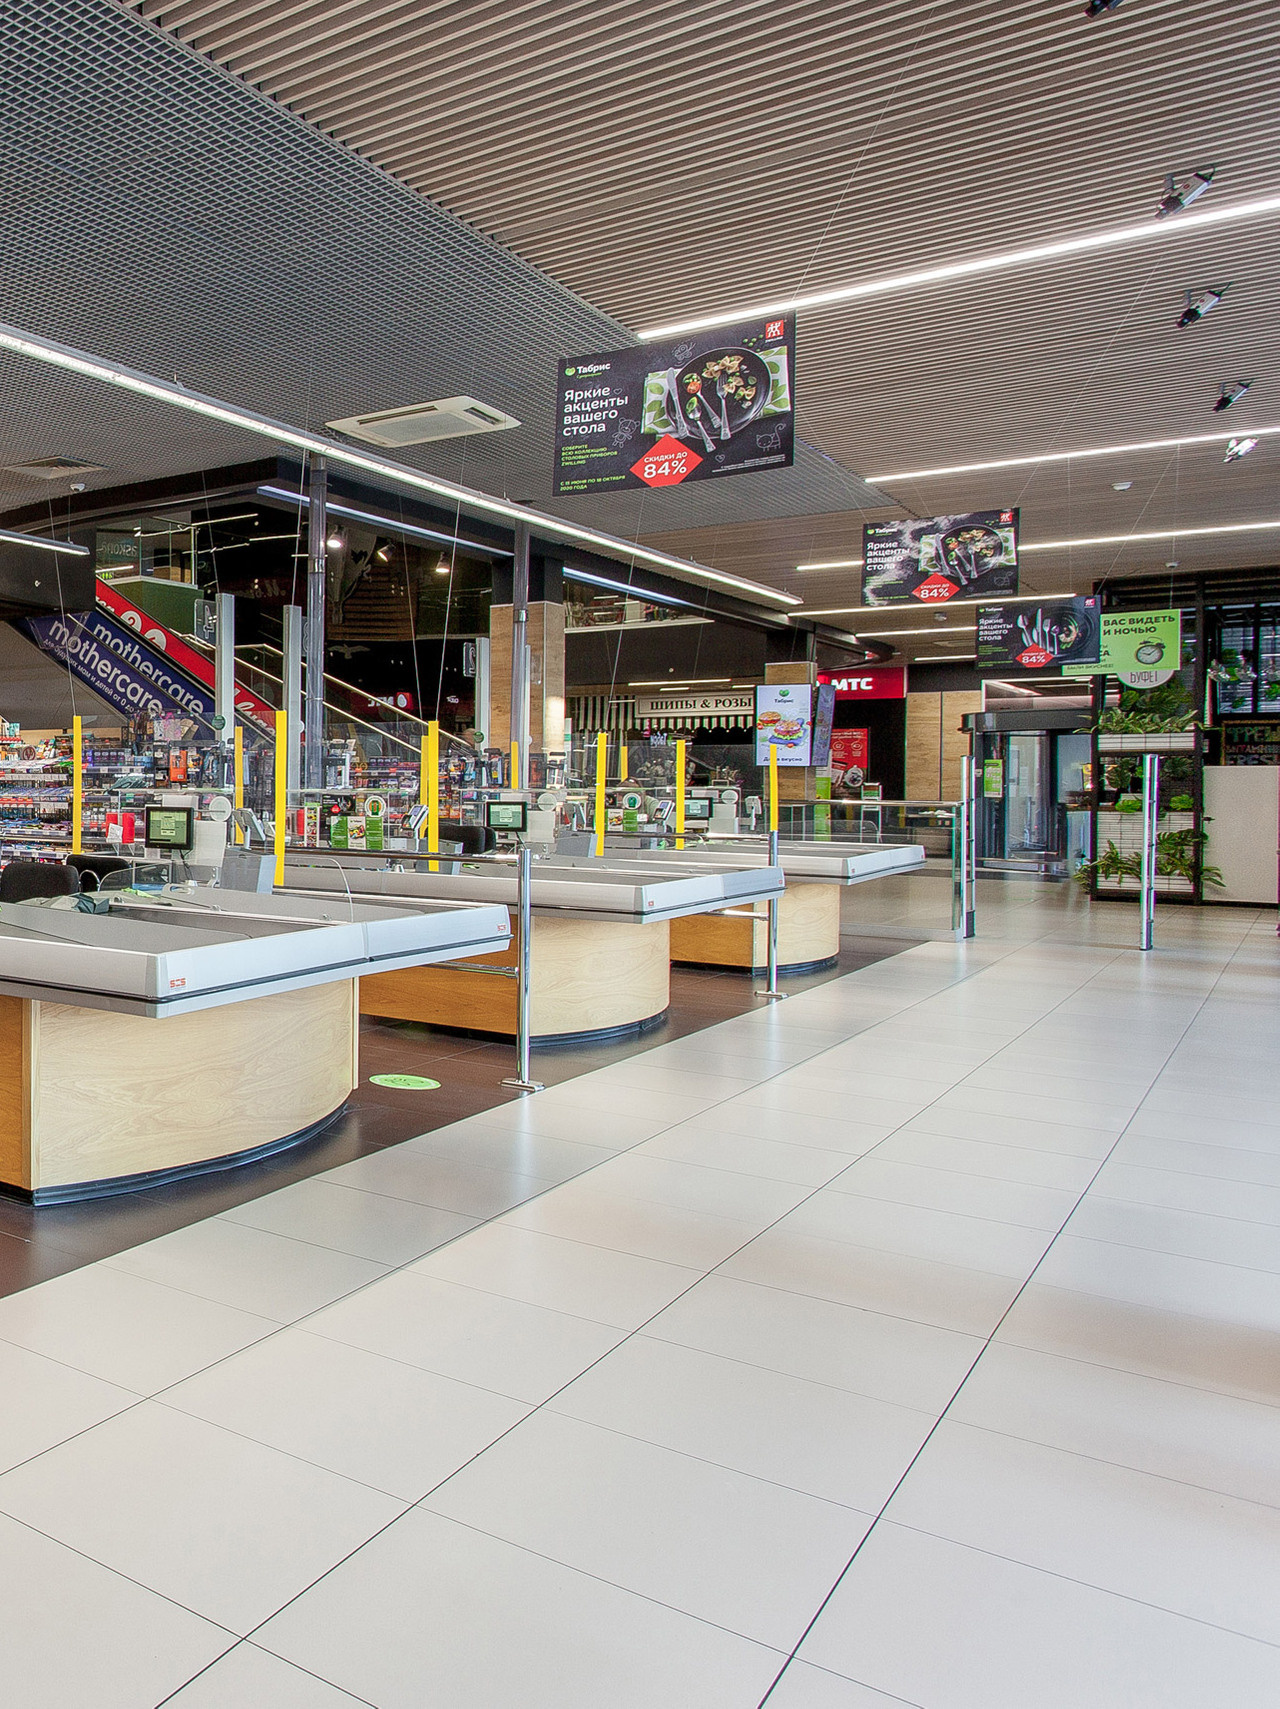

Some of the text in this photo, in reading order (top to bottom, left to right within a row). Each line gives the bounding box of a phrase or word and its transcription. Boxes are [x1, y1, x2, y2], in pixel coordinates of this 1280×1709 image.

[577, 363, 611, 374] Табрис
[564, 387, 610, 402] Яркие
[564, 396, 628, 413] акценты
[563, 410, 618, 425] вашего
[563, 423, 606, 436] стола
[644, 451, 688, 463] СКИДКИ ДО
[643, 459, 687, 478] 84%
[867, 542, 898, 550] Яркие
[867, 548, 910, 557] акценты
[867, 556, 903, 564] вашего
[866, 563, 895, 571] стола
[920, 588, 949, 598] 84%
[1103, 615, 1175, 626] ВАС ВИДЕТЬ
[1114, 626, 1157, 635] НОЧЬЮ
[1022, 655, 1046, 663] 84%
[49, 621, 163, 717] mothercare
[93, 623, 204, 716] mothercare
[831, 677, 873, 691] МТС
[650, 697, 753, 710] ШИПЫ & РОЗЫ
[170, 978, 186, 988] SCS
